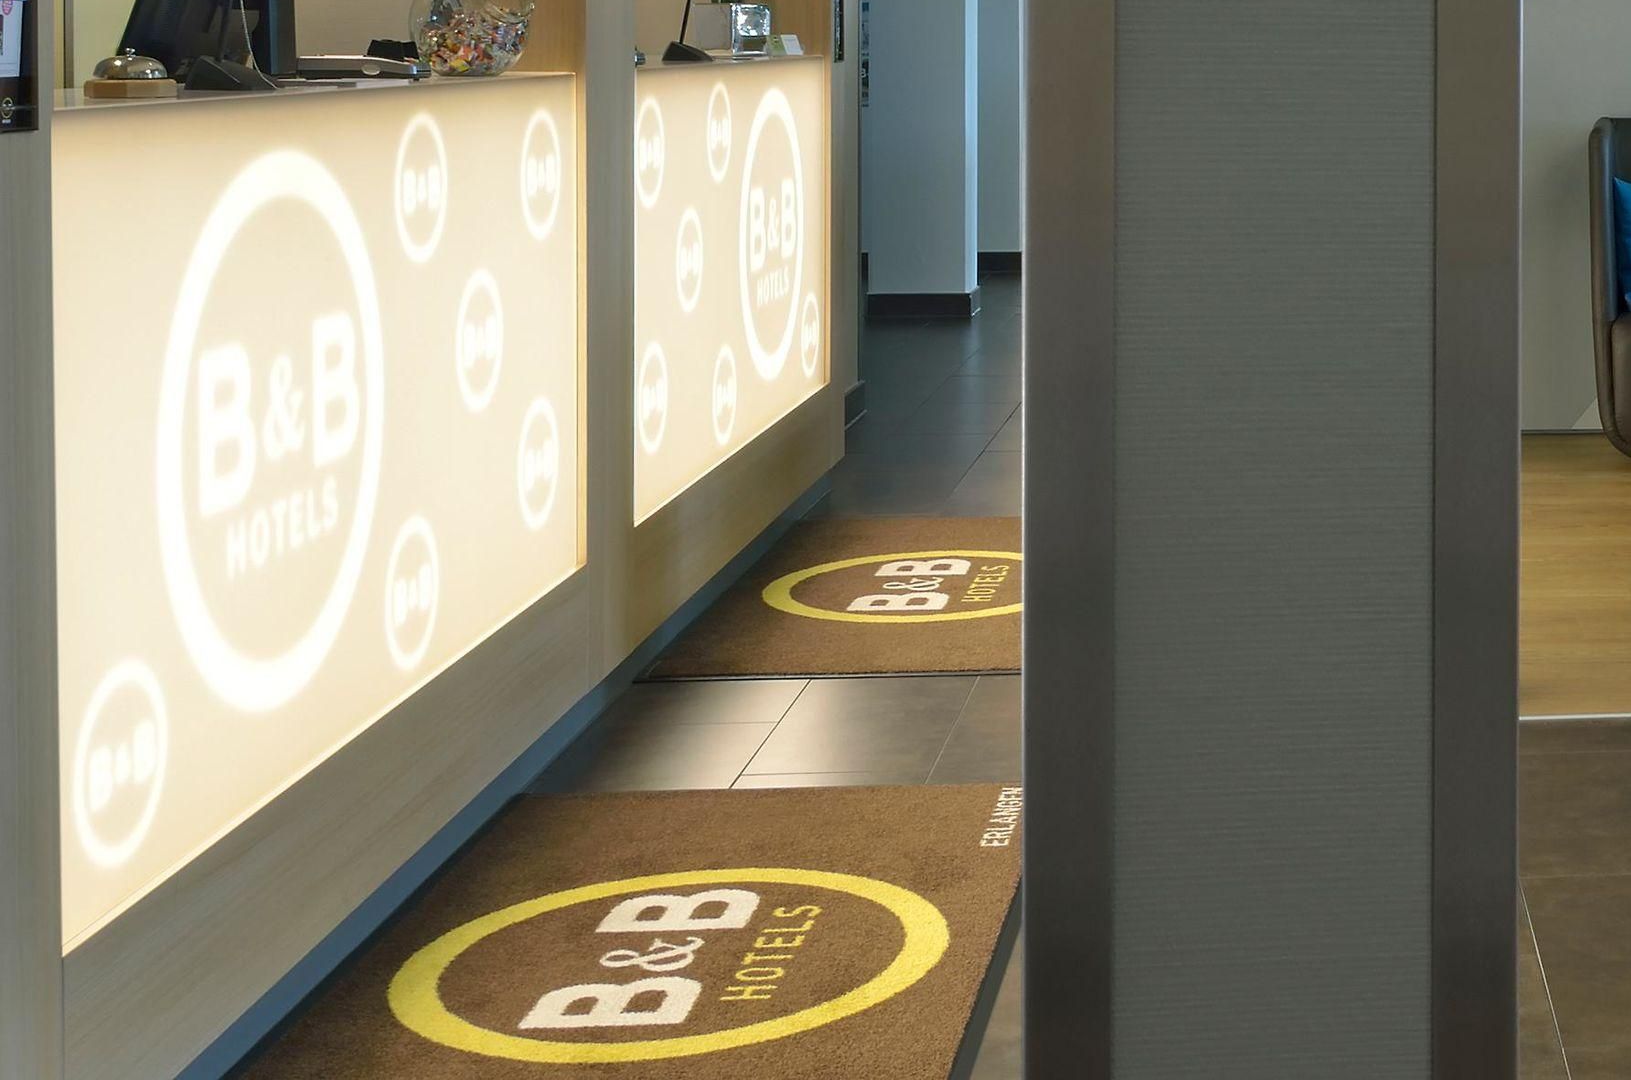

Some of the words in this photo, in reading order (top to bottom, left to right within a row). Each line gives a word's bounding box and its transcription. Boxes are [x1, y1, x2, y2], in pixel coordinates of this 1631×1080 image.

[750, 178, 797, 273] B&B
[757, 266, 790, 307] HOTELS
[199, 309, 360, 518] B&B
[226, 474, 339, 580] HOTELS
[846, 558, 971, 611] B&B
[961, 565, 1010, 602] HOTELS
[518, 887, 761, 1029] B&B
[720, 904, 823, 1001] HOTELS
